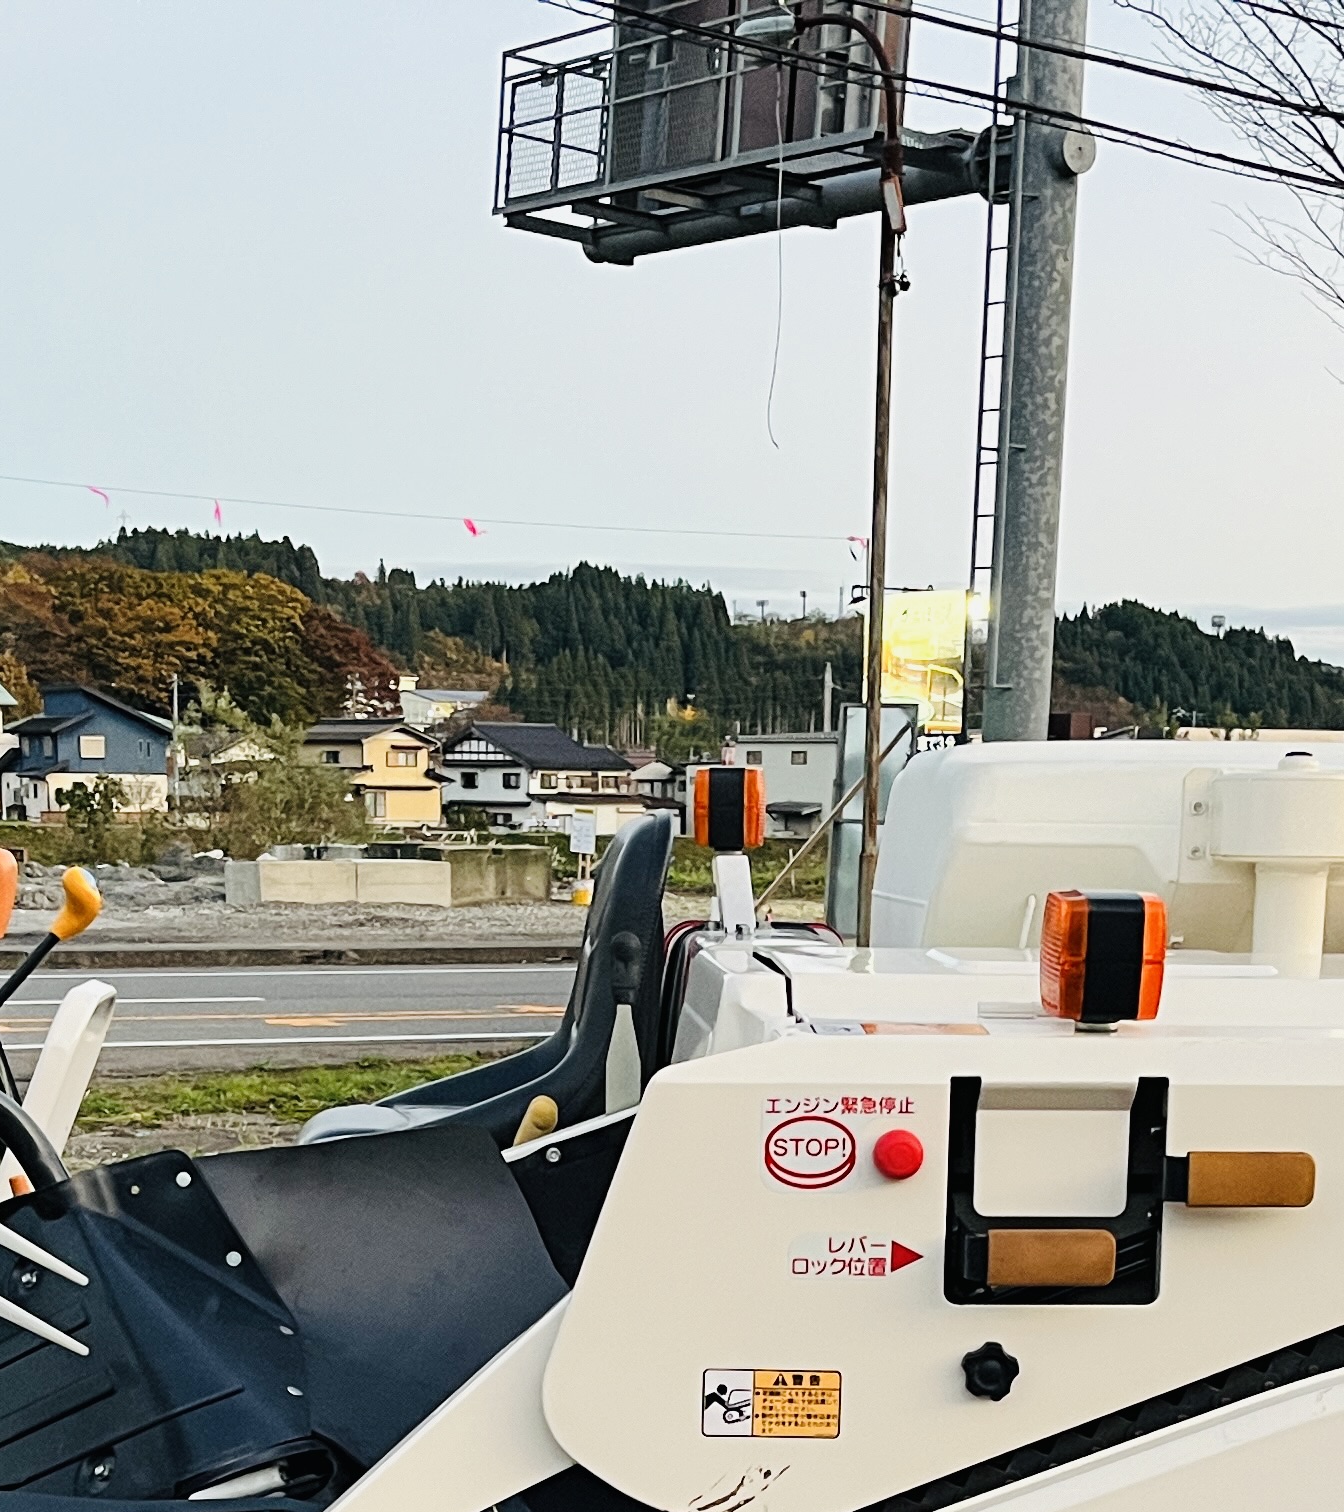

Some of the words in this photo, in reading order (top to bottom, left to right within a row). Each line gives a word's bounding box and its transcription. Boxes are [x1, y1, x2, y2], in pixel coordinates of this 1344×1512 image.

[765, 1096, 915, 1115] エンジン緊急停止
[773, 1137, 847, 1158] STOP!
[827, 1236, 887, 1254] レバー
[791, 1257, 887, 1277] ロック位置
